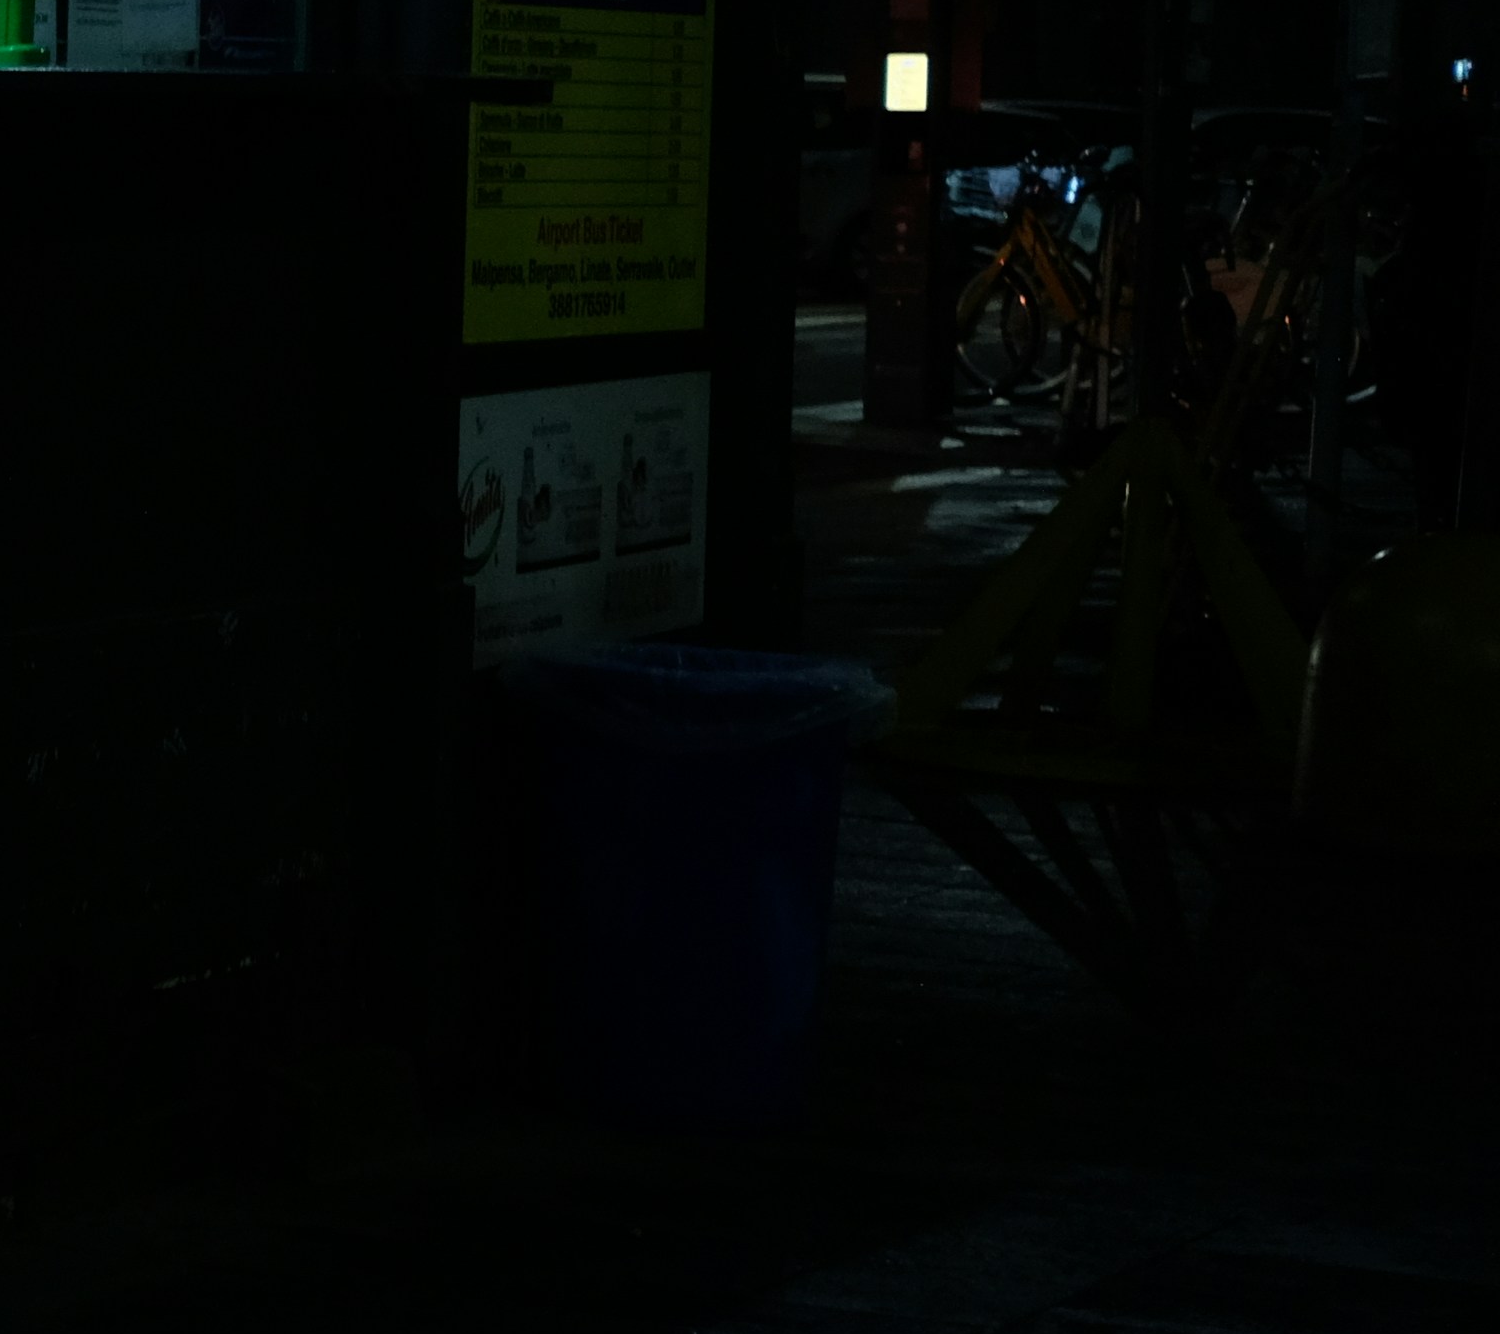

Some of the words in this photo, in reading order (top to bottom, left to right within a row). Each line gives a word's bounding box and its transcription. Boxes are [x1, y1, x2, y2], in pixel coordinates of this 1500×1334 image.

[537, 216, 581, 252] Airport
[583, 216, 607, 244] Bus
[608, 214, 644, 245] Ticket
